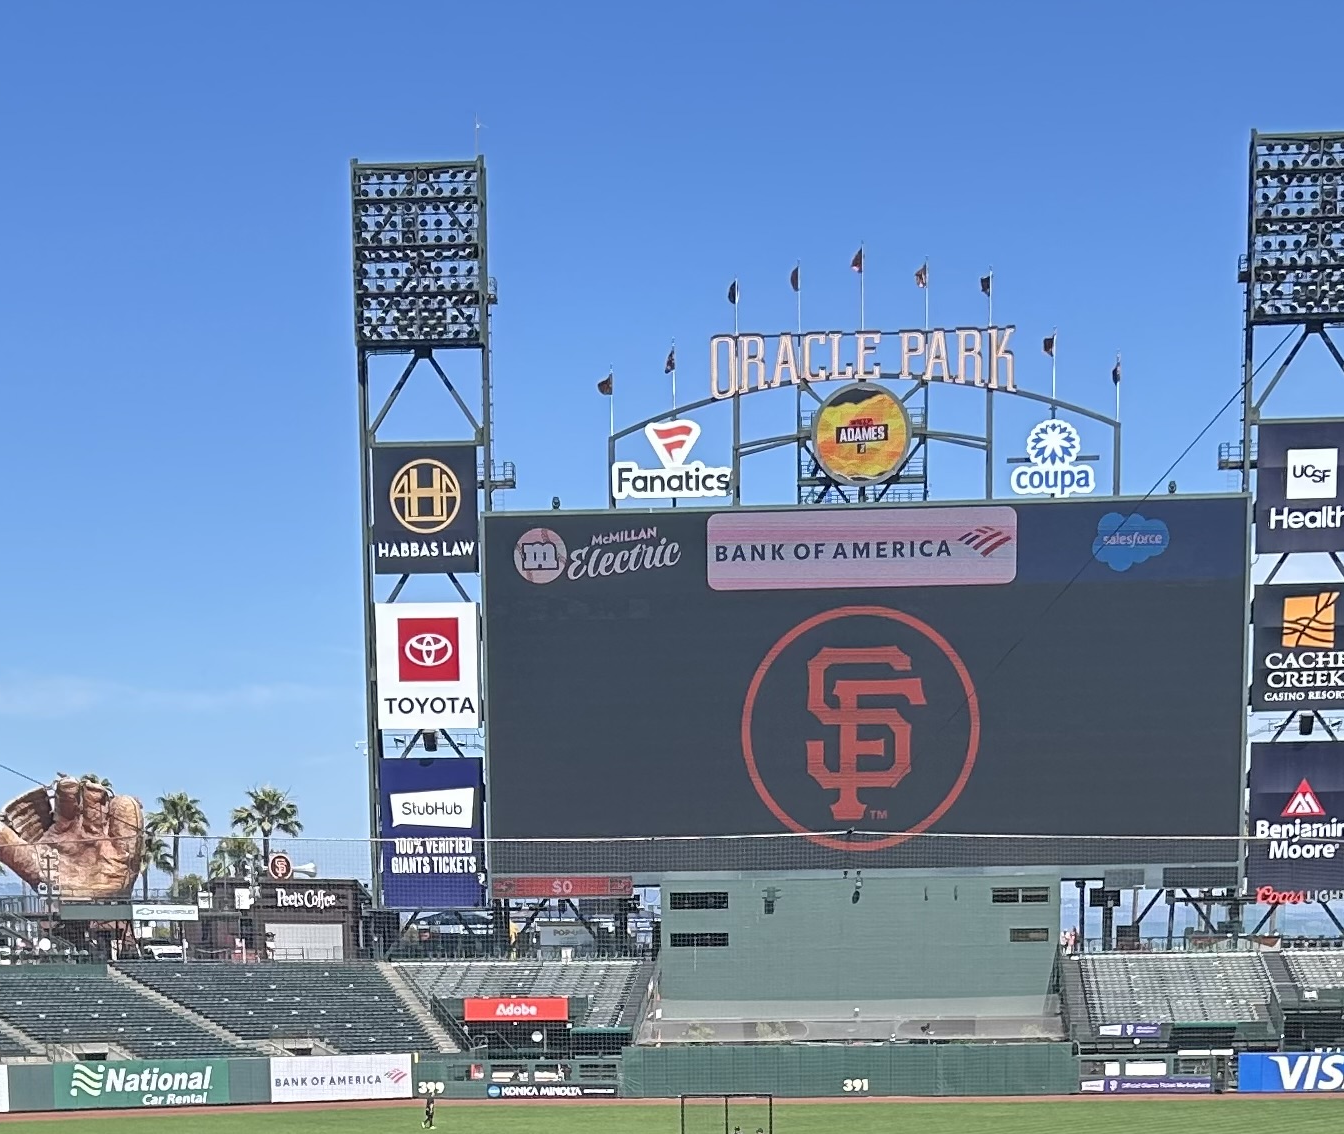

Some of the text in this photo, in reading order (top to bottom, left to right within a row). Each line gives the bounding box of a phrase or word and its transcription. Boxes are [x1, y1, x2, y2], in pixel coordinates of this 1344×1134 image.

[710, 325, 1018, 399] ORACLE PARK
[839, 425, 886, 443] ADAMES
[617, 467, 730, 494] Fanatics
[1016, 467, 1090, 496] coupa
[1292, 464, 1332, 483] UCSF
[591, 526, 658, 546] McMILLAN
[1103, 531, 1162, 549] salesforce
[377, 541, 475, 558] HABBAS LAW
[567, 536, 682, 581] Electric
[715, 540, 952, 563] BANK OF AMERICA
[384, 696, 476, 714] TOYOTA
[1264, 691, 1306, 702] CASINO
[806, 645, 927, 821] SF
[401, 801, 463, 816] StubHub
[870, 810, 888, 819] TM
[394, 836, 473, 855] 100% VERIFIED
[1268, 841, 1335, 859] Moore
[391, 856, 477, 874] GIANTS TICKETS
[304, 889, 336, 910] Coffee
[1256, 886, 1305, 905] Coors
[495, 1003, 537, 1016] Adobe
[105, 1064, 211, 1093] National
[275, 1075, 382, 1087] BANK OF AMERICA
[842, 1079, 869, 1092] 391
[418, 1082, 445, 1094] 399
[501, 1086, 539, 1096] KONICA
[539, 1086, 582, 1096] MINOLTA
[142, 1092, 207, 1106] Car Rental
